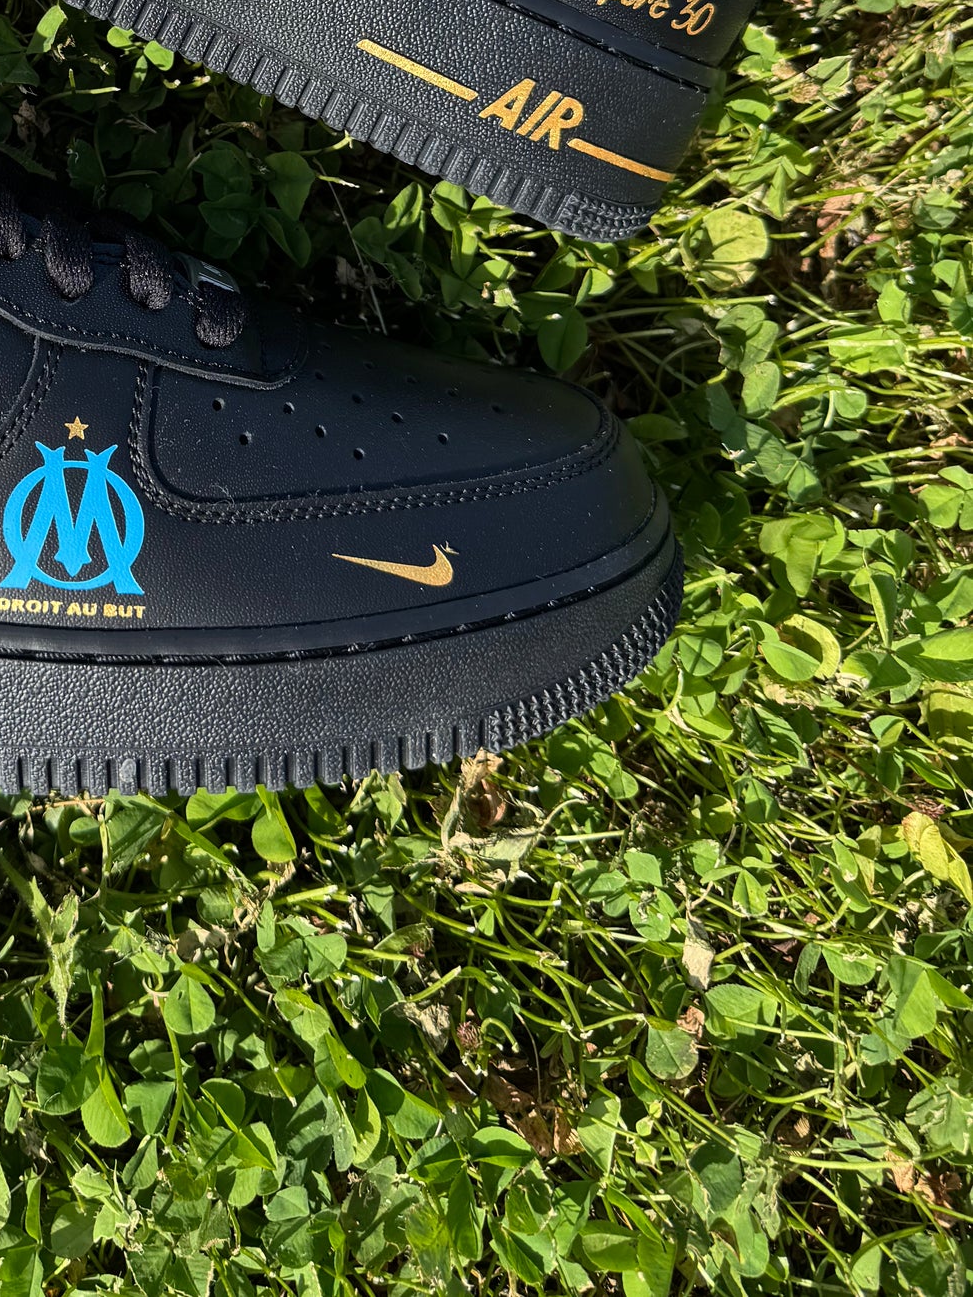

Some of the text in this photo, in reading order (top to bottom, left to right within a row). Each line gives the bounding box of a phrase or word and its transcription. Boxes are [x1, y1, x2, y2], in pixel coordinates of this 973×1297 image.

[478, 78, 585, 152] AIR
[66, 601, 97, 617] AU
[102, 603, 146, 619] BUT
